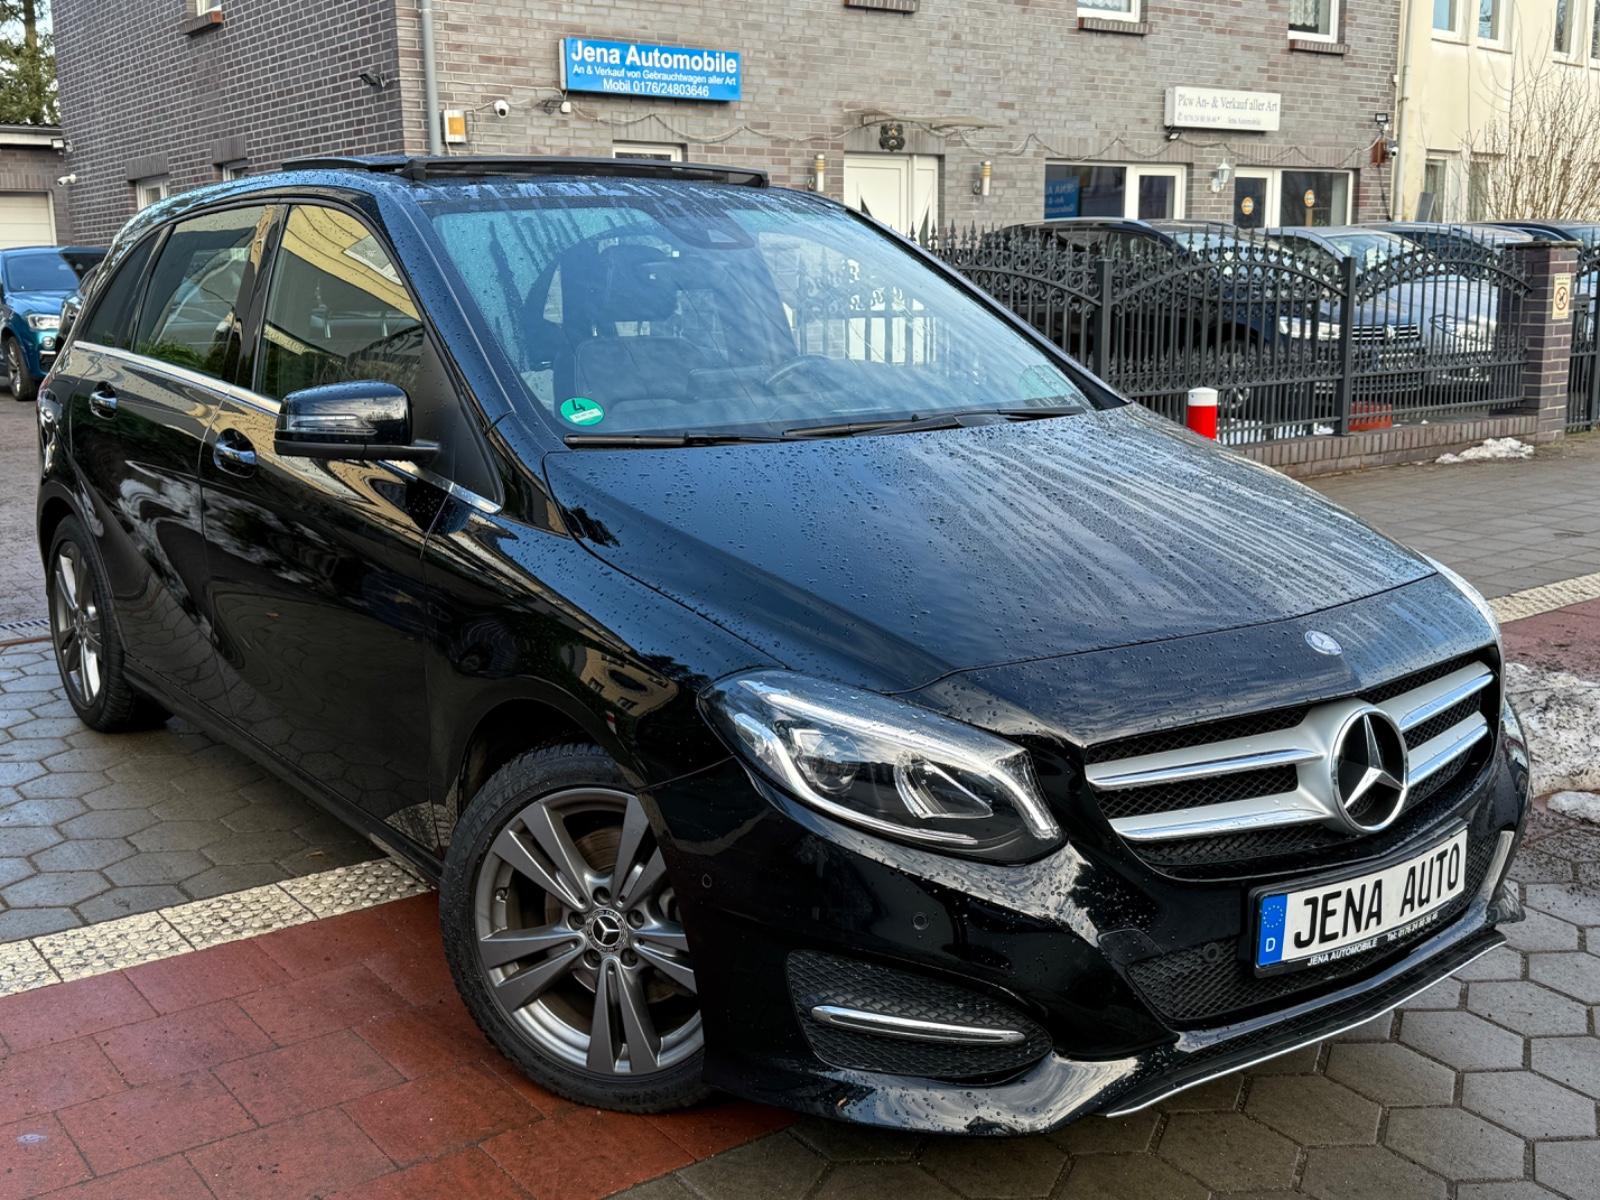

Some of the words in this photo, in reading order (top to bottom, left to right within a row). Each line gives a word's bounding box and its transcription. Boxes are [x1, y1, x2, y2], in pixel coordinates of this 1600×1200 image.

[571, 40, 621, 65] Jena
[625, 45, 737, 74] Automobile
[573, 64, 585, 74] An
[586, 66, 593, 75] &
[594, 66, 626, 78] Verkauf
[626, 70, 641, 79] von
[642, 71, 707, 86] Gebrauchtwagen
[708, 75, 723, 85] aller
[724, 76, 737, 86] Art
[603, 78, 631, 93] Mobil
[632, 81, 710, 97] 0176/24803646
[1220, 96, 1249, 111] Verkauf
[1249, 98, 1265, 111] aller
[571, 398, 586, 412] 4
[1294, 878, 1383, 949] JENA
[1400, 842, 1461, 918] AUTO
[1265, 937, 1276, 953] D
[1307, 953, 1329, 967] JENA
[1330, 938, 1378, 961] AUTOMOBILE
